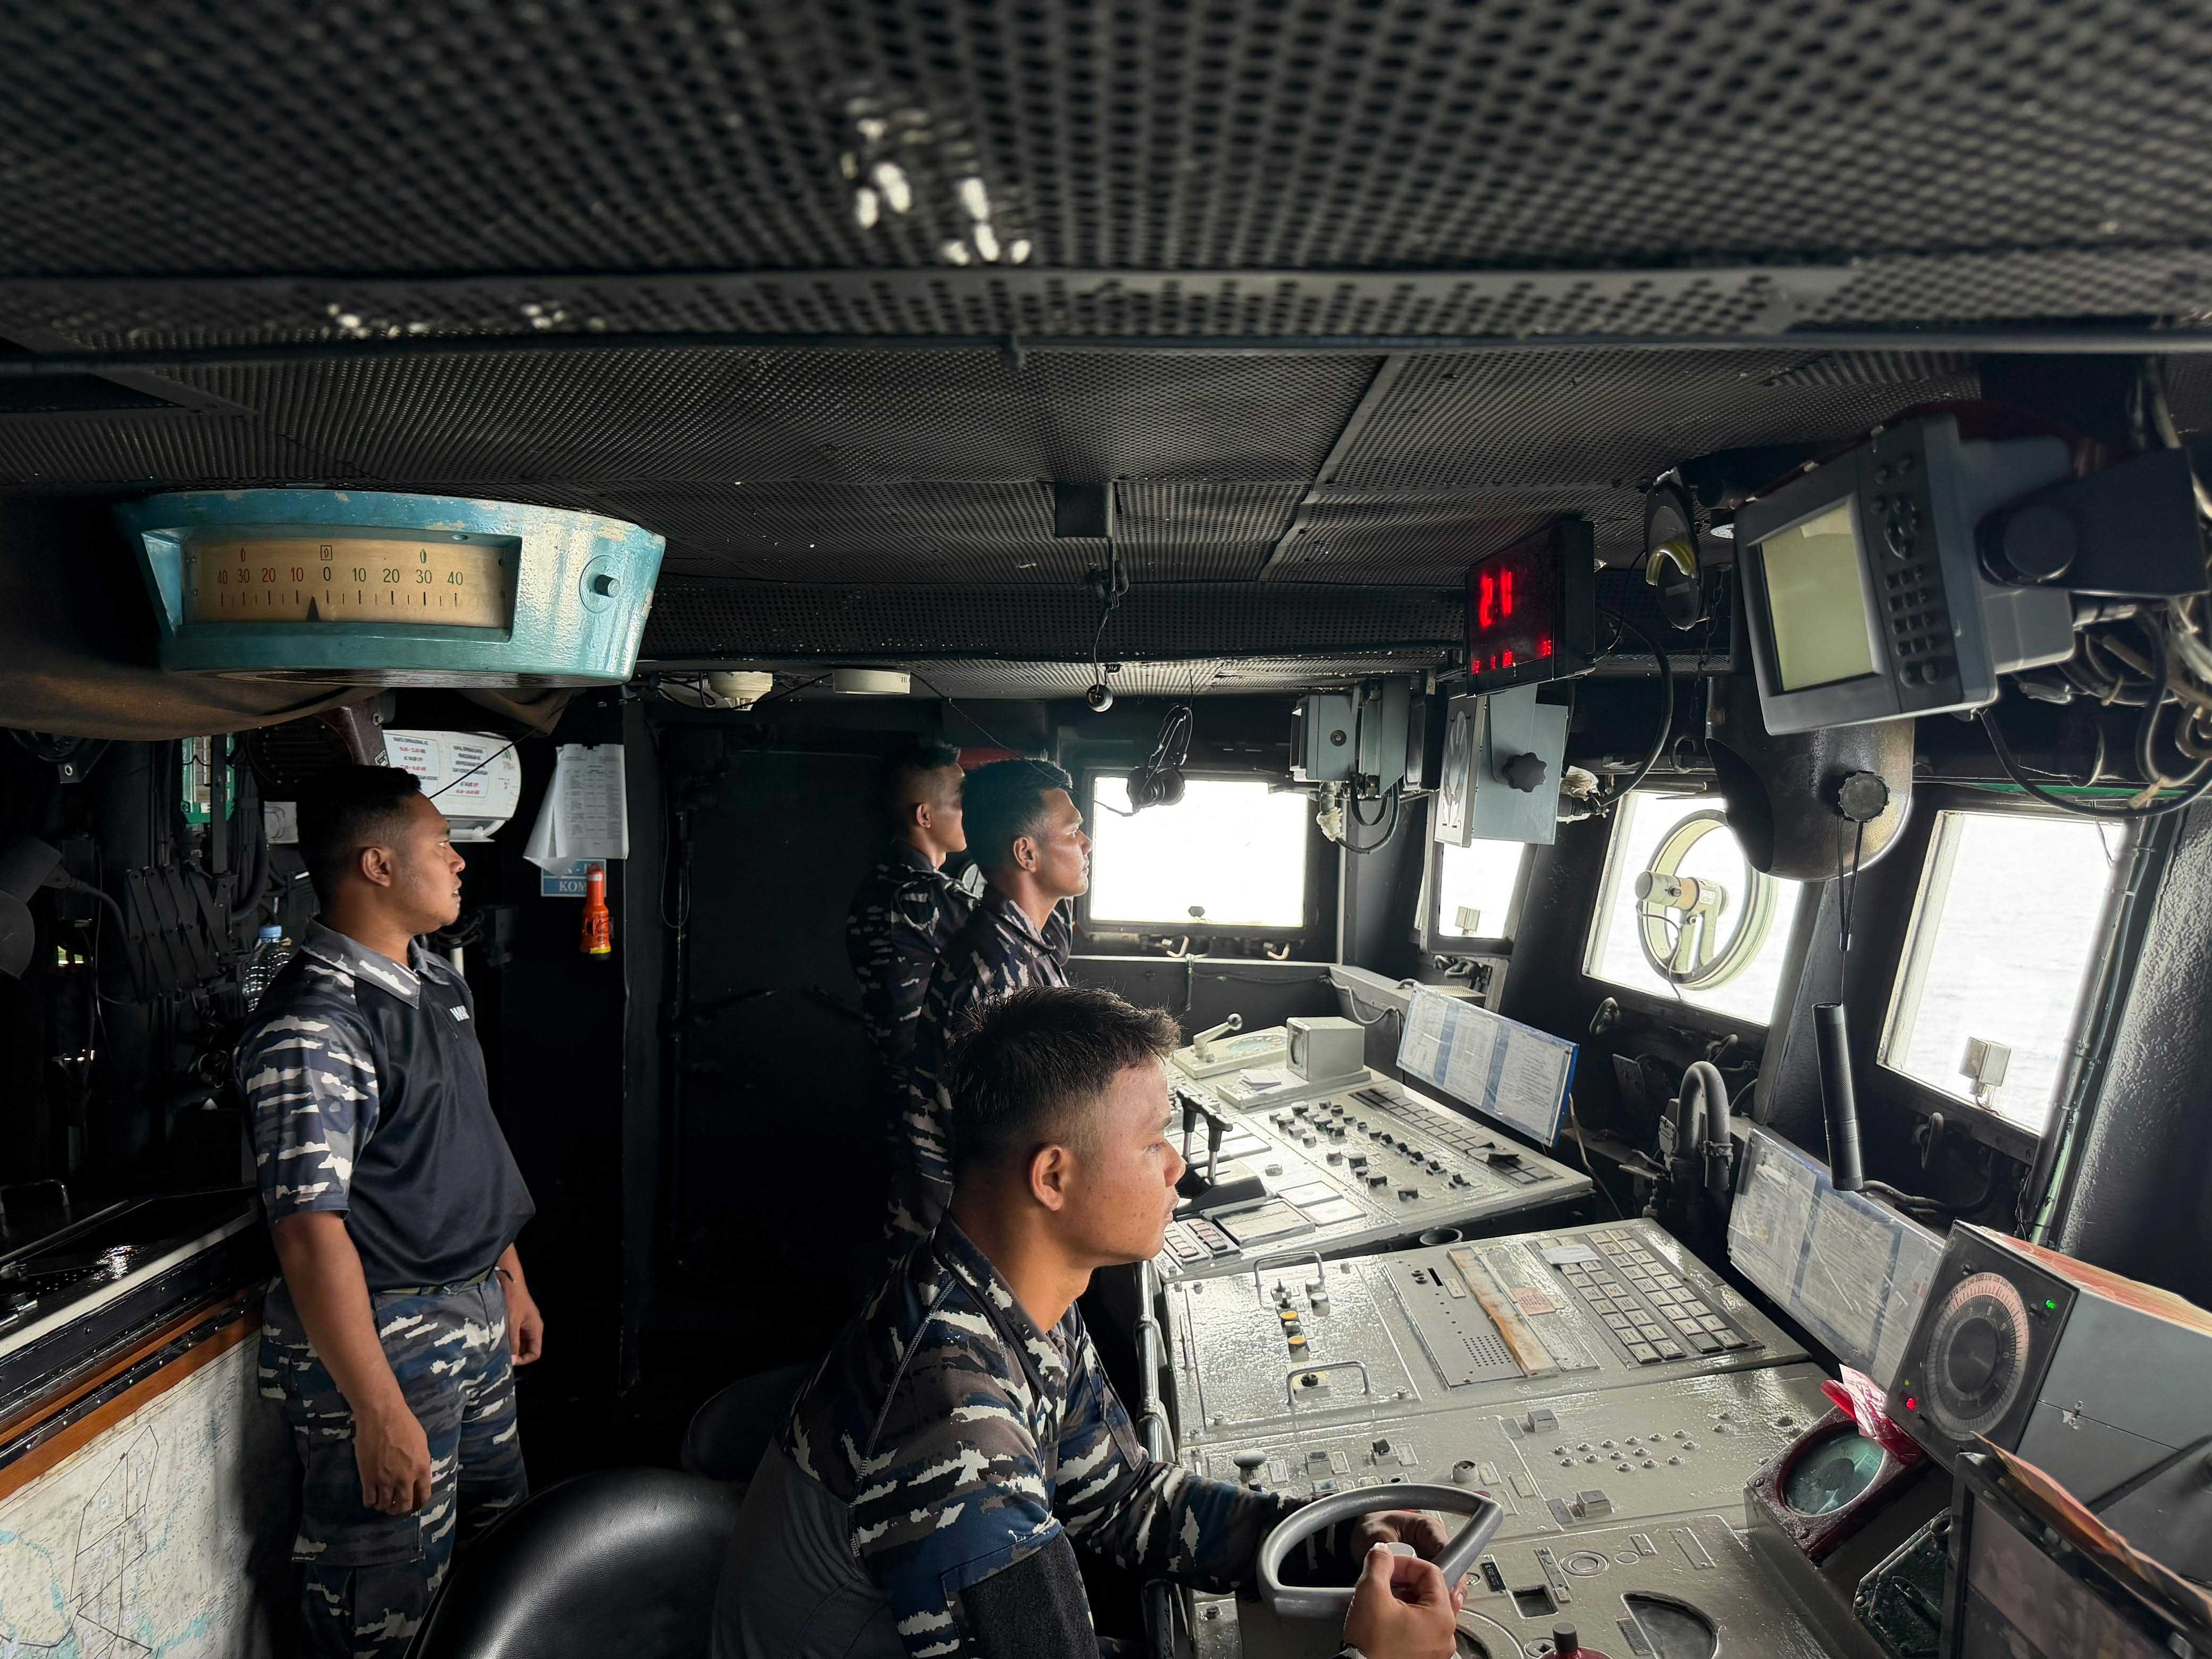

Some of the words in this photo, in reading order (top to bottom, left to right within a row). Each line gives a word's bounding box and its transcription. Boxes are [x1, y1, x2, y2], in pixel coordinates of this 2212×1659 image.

[217, 569, 228, 584] 40
[238, 568, 250, 583] 30
[262, 567, 276, 582] 20
[291, 567, 304, 582] 10
[323, 566, 331, 581] 0
[353, 567, 366, 582] 10
[383, 568, 400, 583] 20
[416, 569, 432, 584] 30
[447, 571, 463, 585] 40
[1975, 1274, 1984, 1283] 300
[1987, 1305, 1992, 1316] 8
[2000, 1322, 2007, 1331] 9
